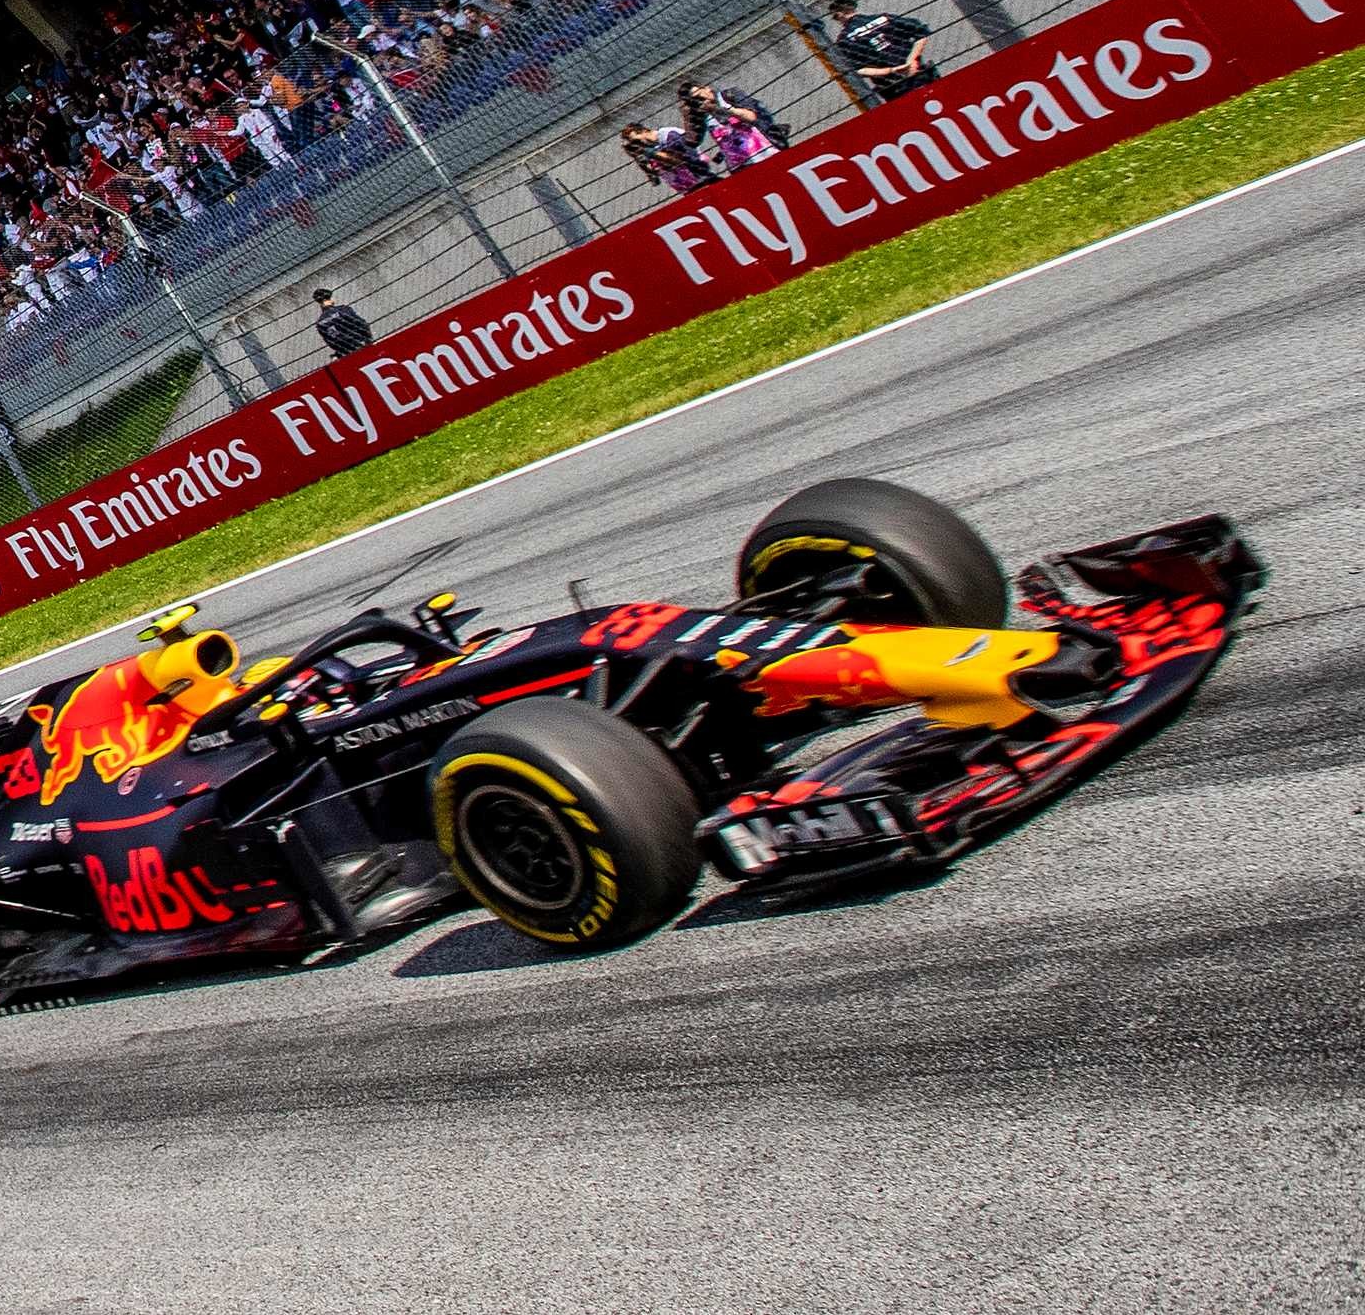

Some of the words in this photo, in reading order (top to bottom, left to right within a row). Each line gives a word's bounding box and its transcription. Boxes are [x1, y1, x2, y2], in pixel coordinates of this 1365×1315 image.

[653, 193, 806, 284] Fly
[788, 19, 1211, 226] Emirates
[271, 386, 377, 455] Fly
[360, 272, 633, 415] Emirates
[5, 523, 84, 578] Fly
[68, 439, 261, 549] Emirates
[335, 718, 403, 752] ASTON
[401, 695, 482, 733] MARTIN
